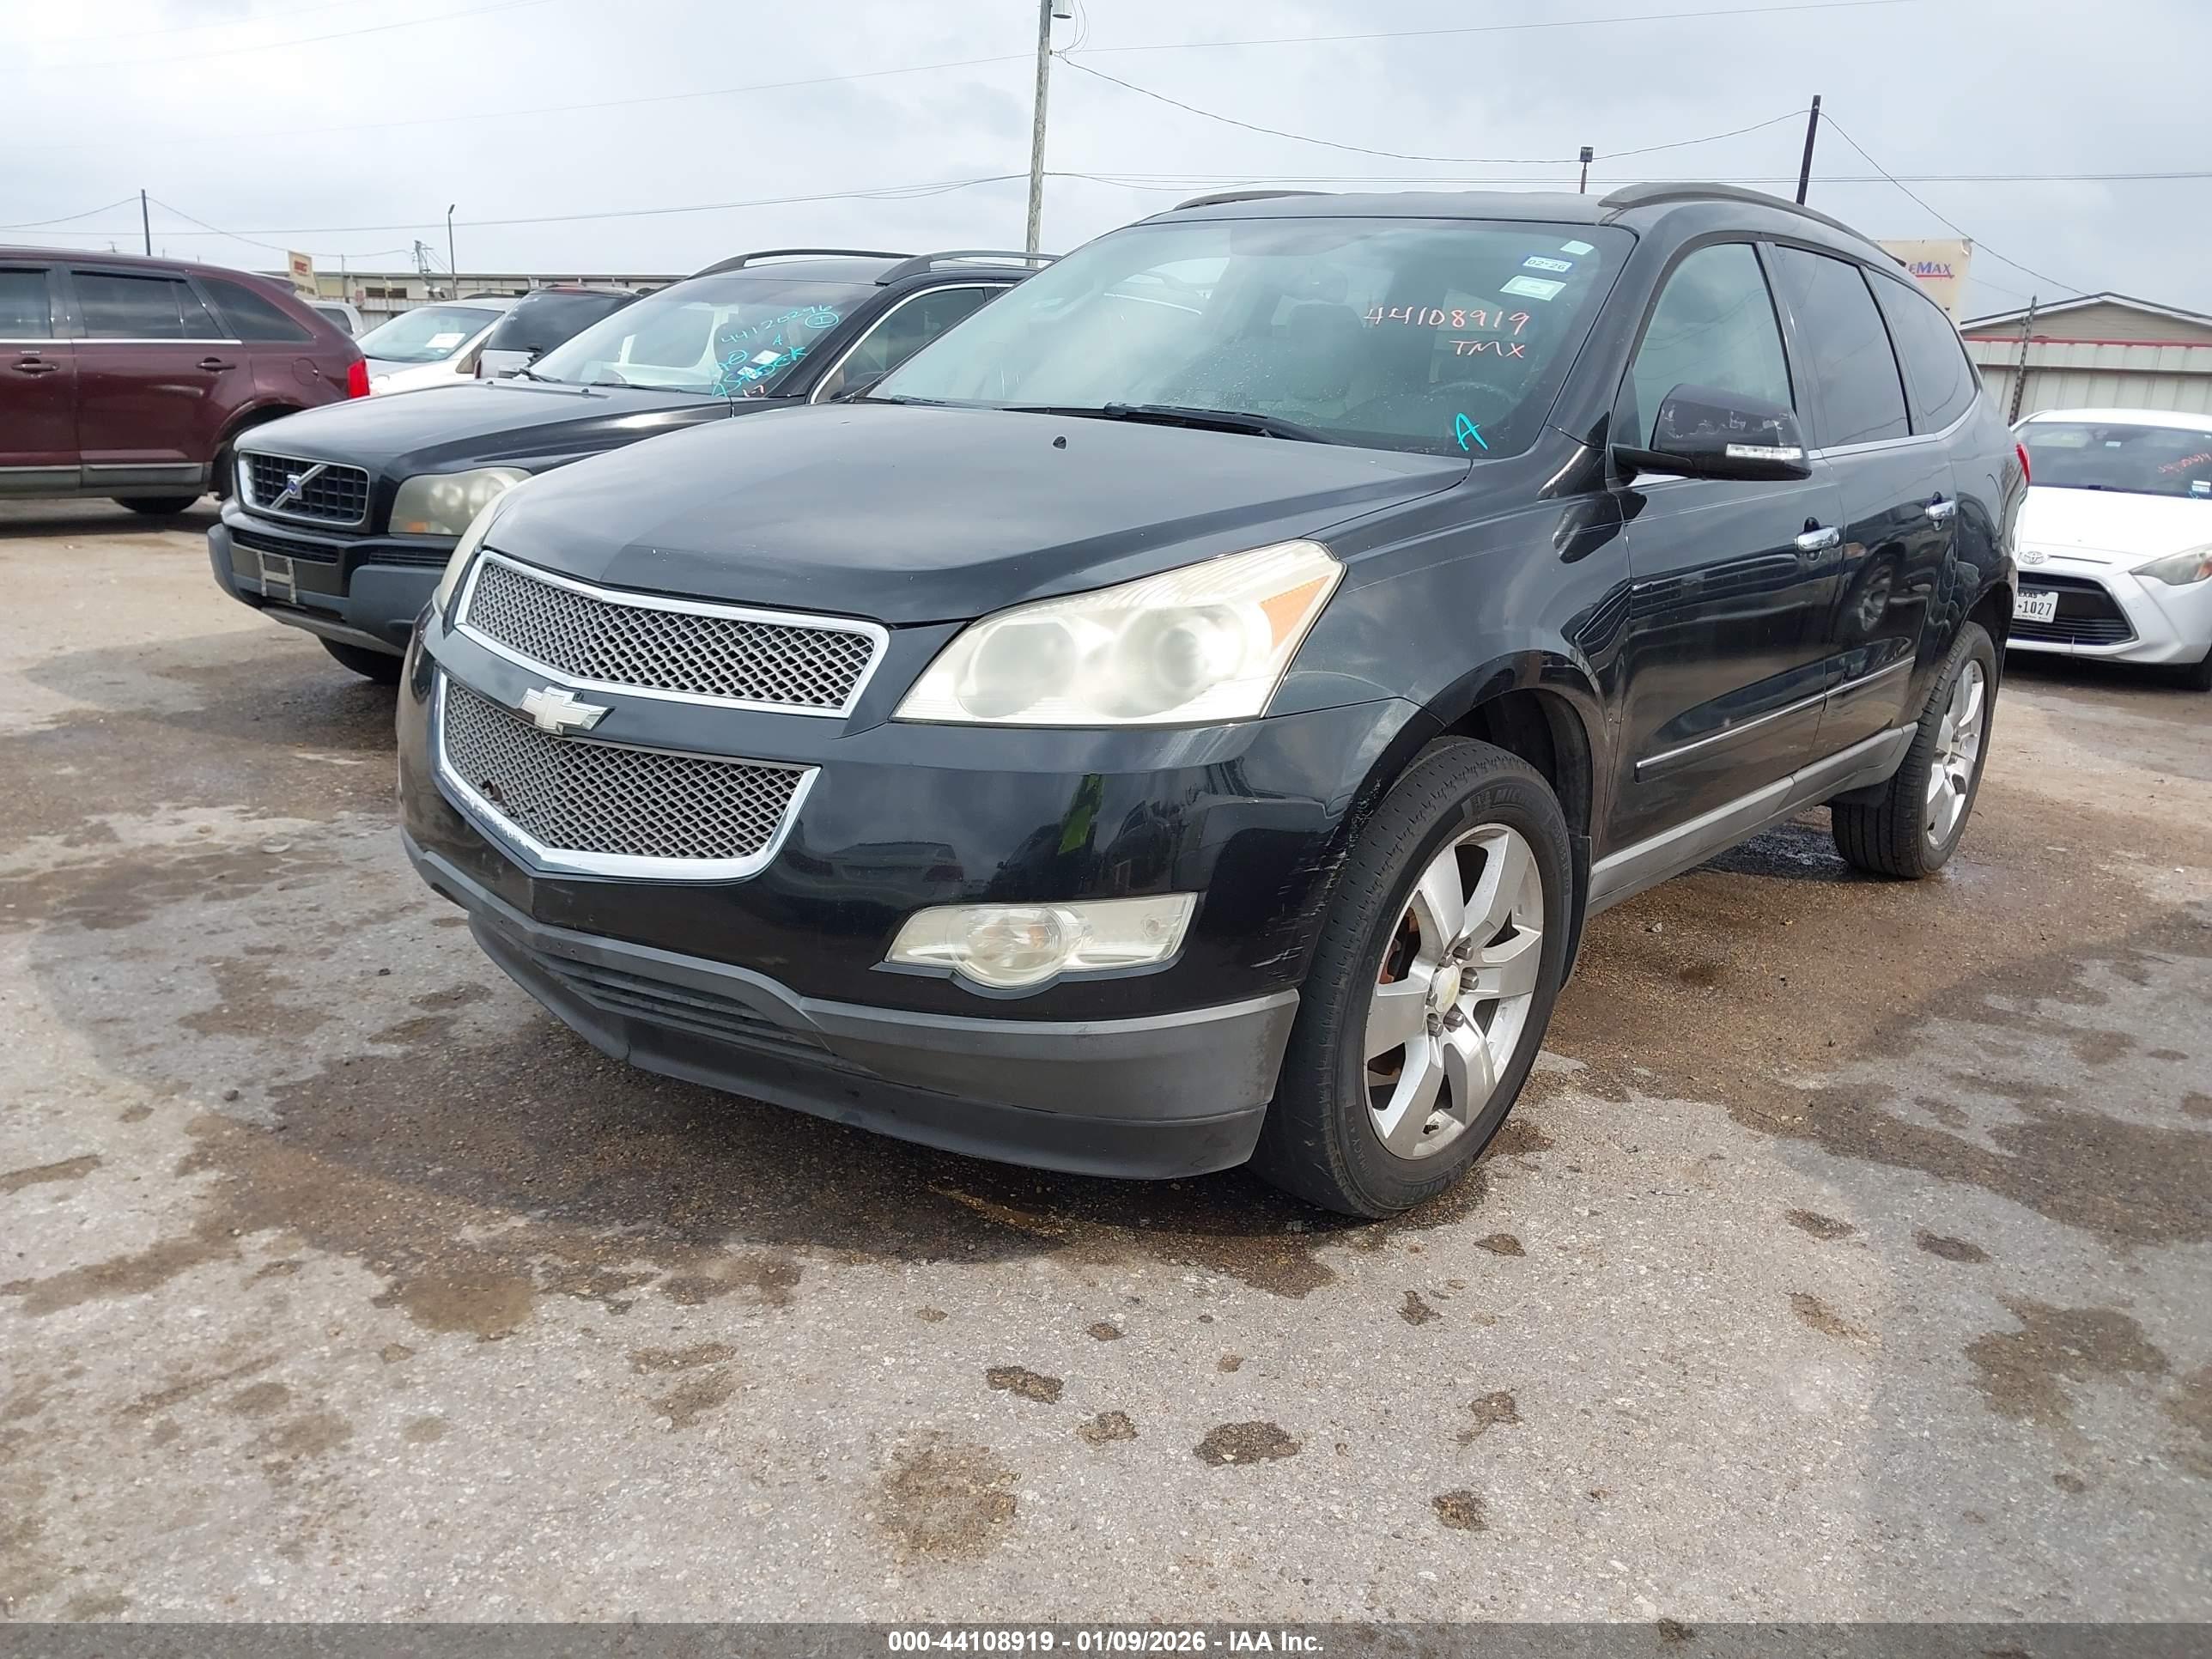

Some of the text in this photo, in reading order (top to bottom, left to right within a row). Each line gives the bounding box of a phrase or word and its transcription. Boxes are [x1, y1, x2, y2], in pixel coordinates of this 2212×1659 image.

[1364, 307, 1530, 335] 44108919
[1449, 340, 1525, 358] TMX
[1455, 412, 1489, 452] A
[2022, 600, 2053, 616] 1027
